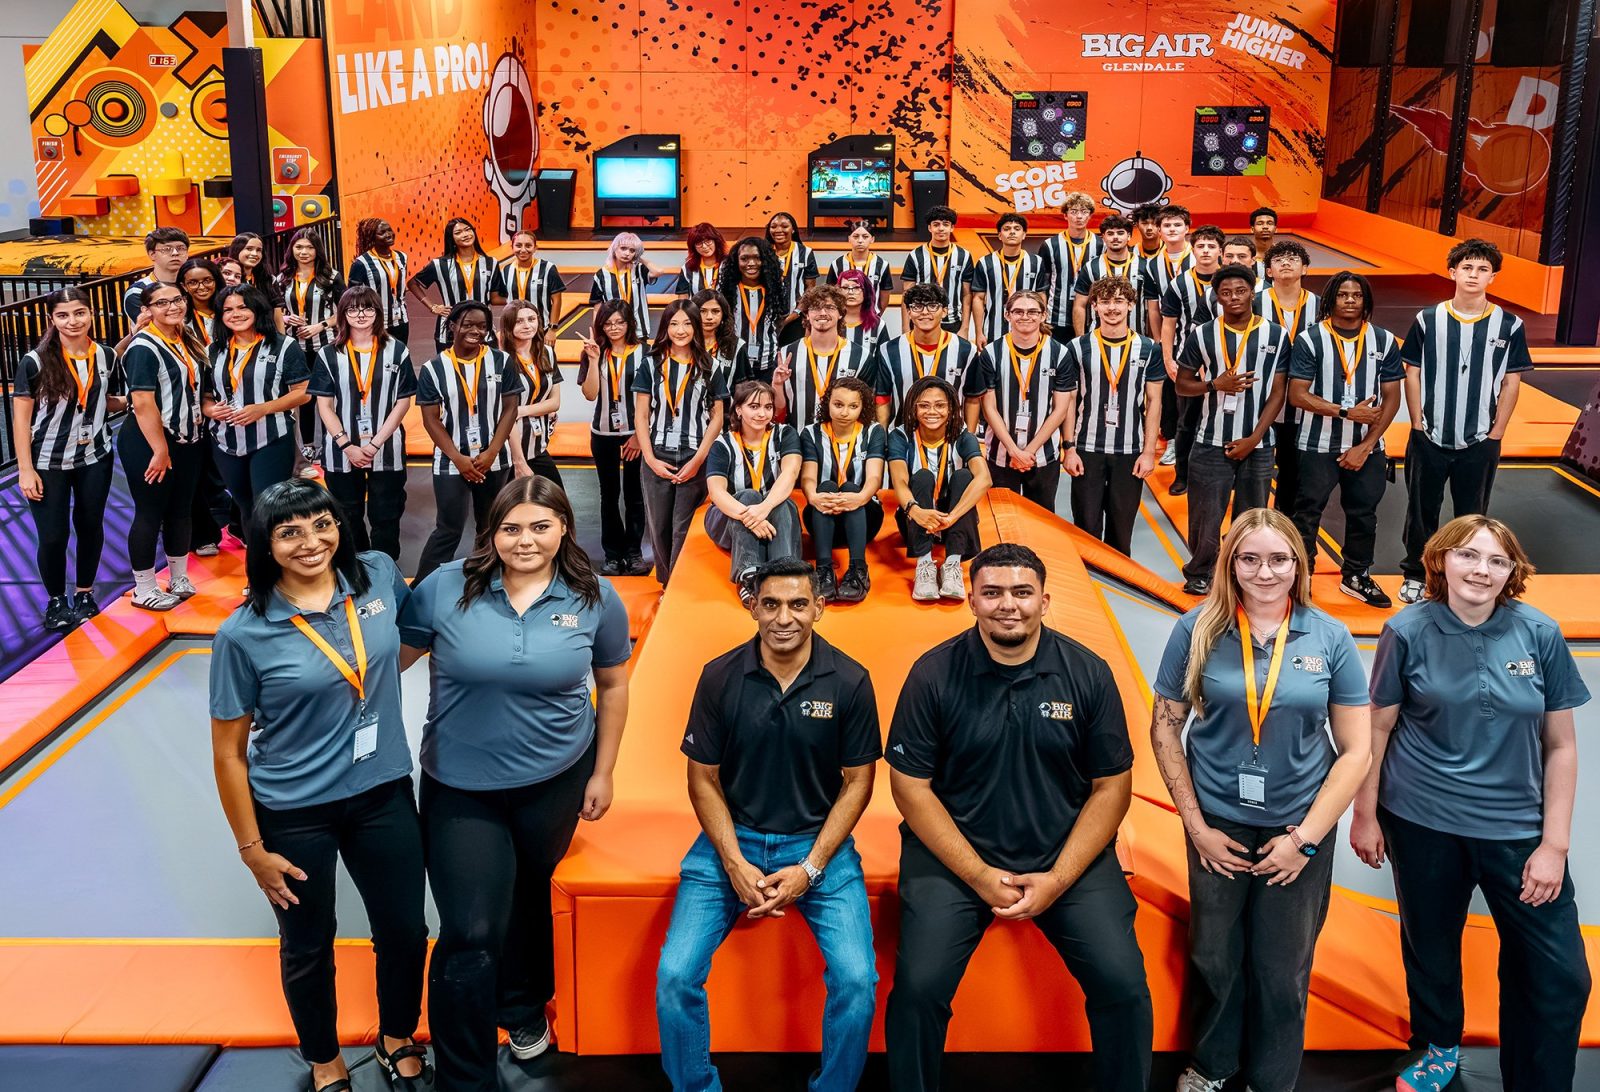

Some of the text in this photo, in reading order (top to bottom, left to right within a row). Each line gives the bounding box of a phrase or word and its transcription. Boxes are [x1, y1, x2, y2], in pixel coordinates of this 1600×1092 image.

[1227, 12, 1295, 45] JUMP
[1081, 33, 1215, 58] BIG AIR
[1220, 28, 1307, 71] HIGHER
[1102, 62, 1185, 72] GLENDALE
[336, 42, 490, 115] LIKE A PRO!
[995, 161, 1078, 193] SCORE
[1013, 183, 1067, 213] BIG
[367, 598, 382, 609] BIG
[371, 604, 387, 616] AIR
[560, 620, 578, 628] AIR
[1303, 657, 1322, 665] BIG
[1304, 664, 1324, 673] AIR
[811, 700, 833, 710] BIG
[1051, 700, 1073, 711] BIG
[810, 709, 833, 719] AIR
[1050, 710, 1073, 720] AIR
